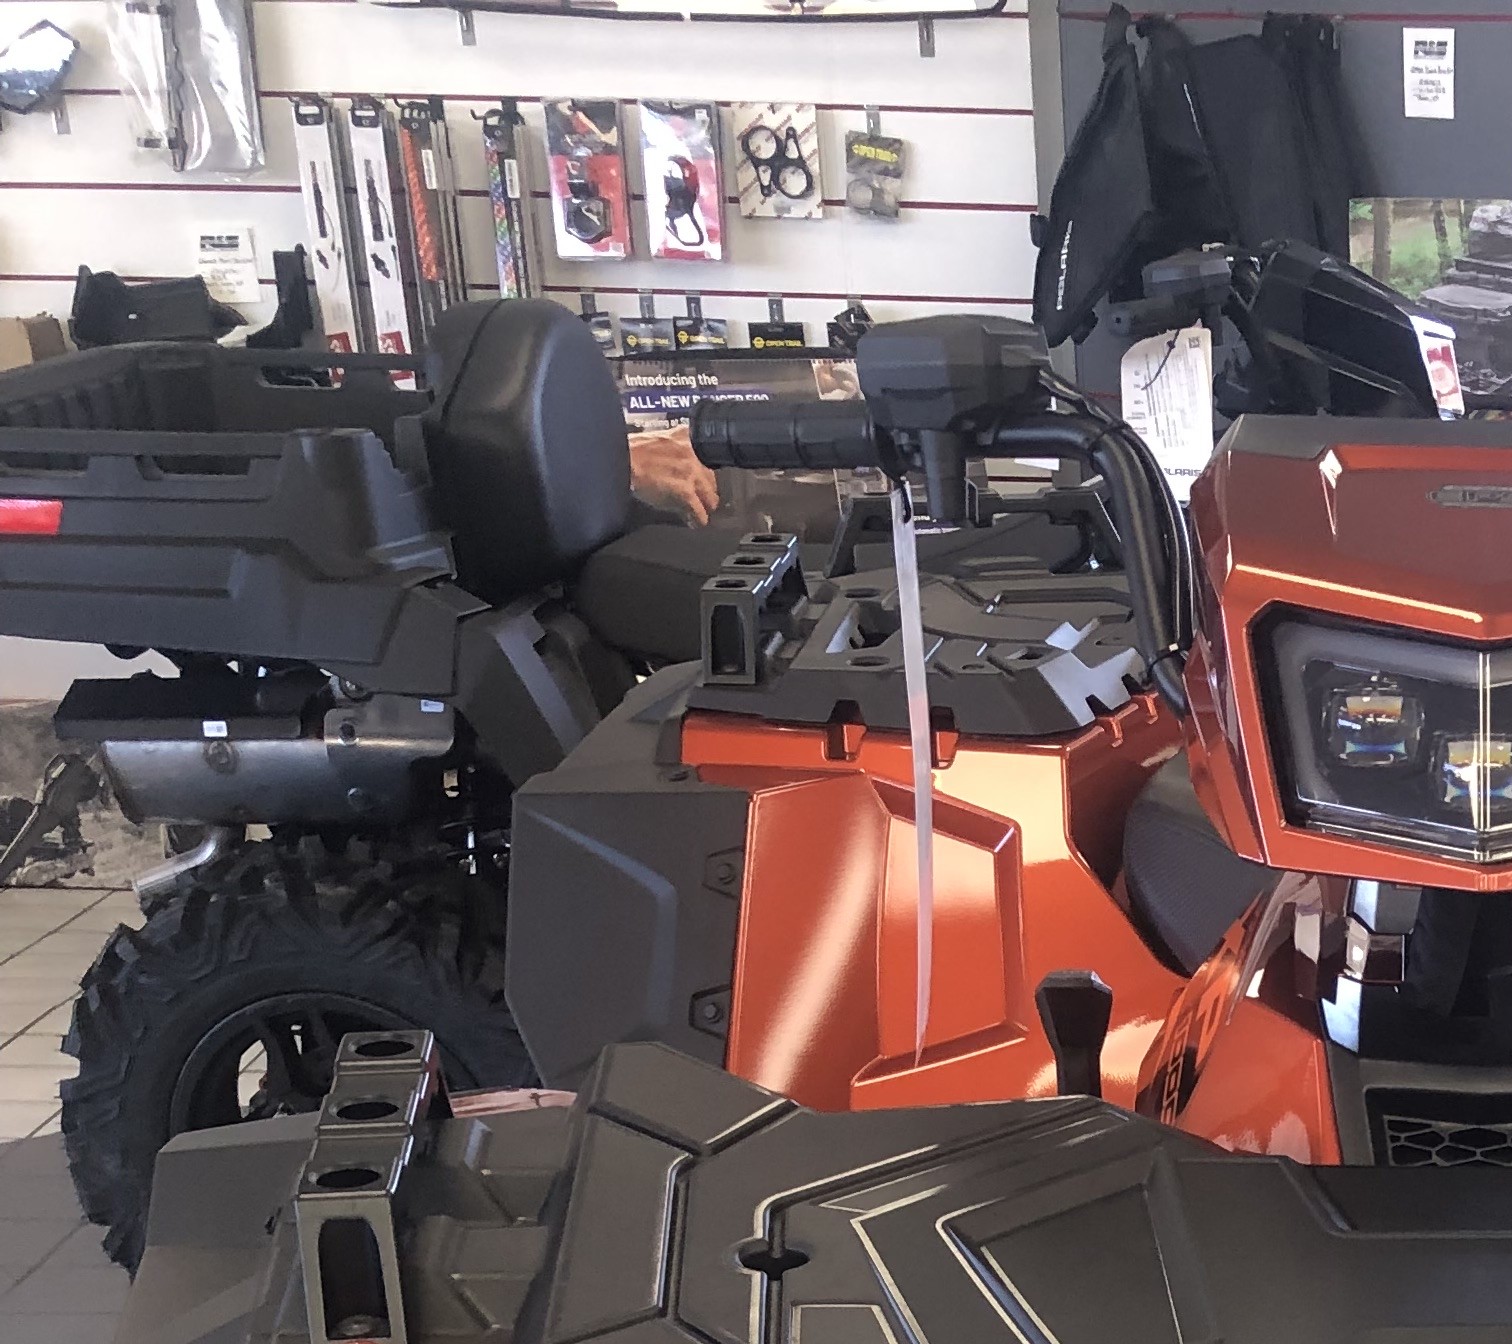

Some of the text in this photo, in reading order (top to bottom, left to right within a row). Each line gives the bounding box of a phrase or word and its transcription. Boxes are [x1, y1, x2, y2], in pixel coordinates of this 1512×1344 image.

[625, 373, 718, 387] Introducing the
[630, 395, 690, 409] ALL-NEW
